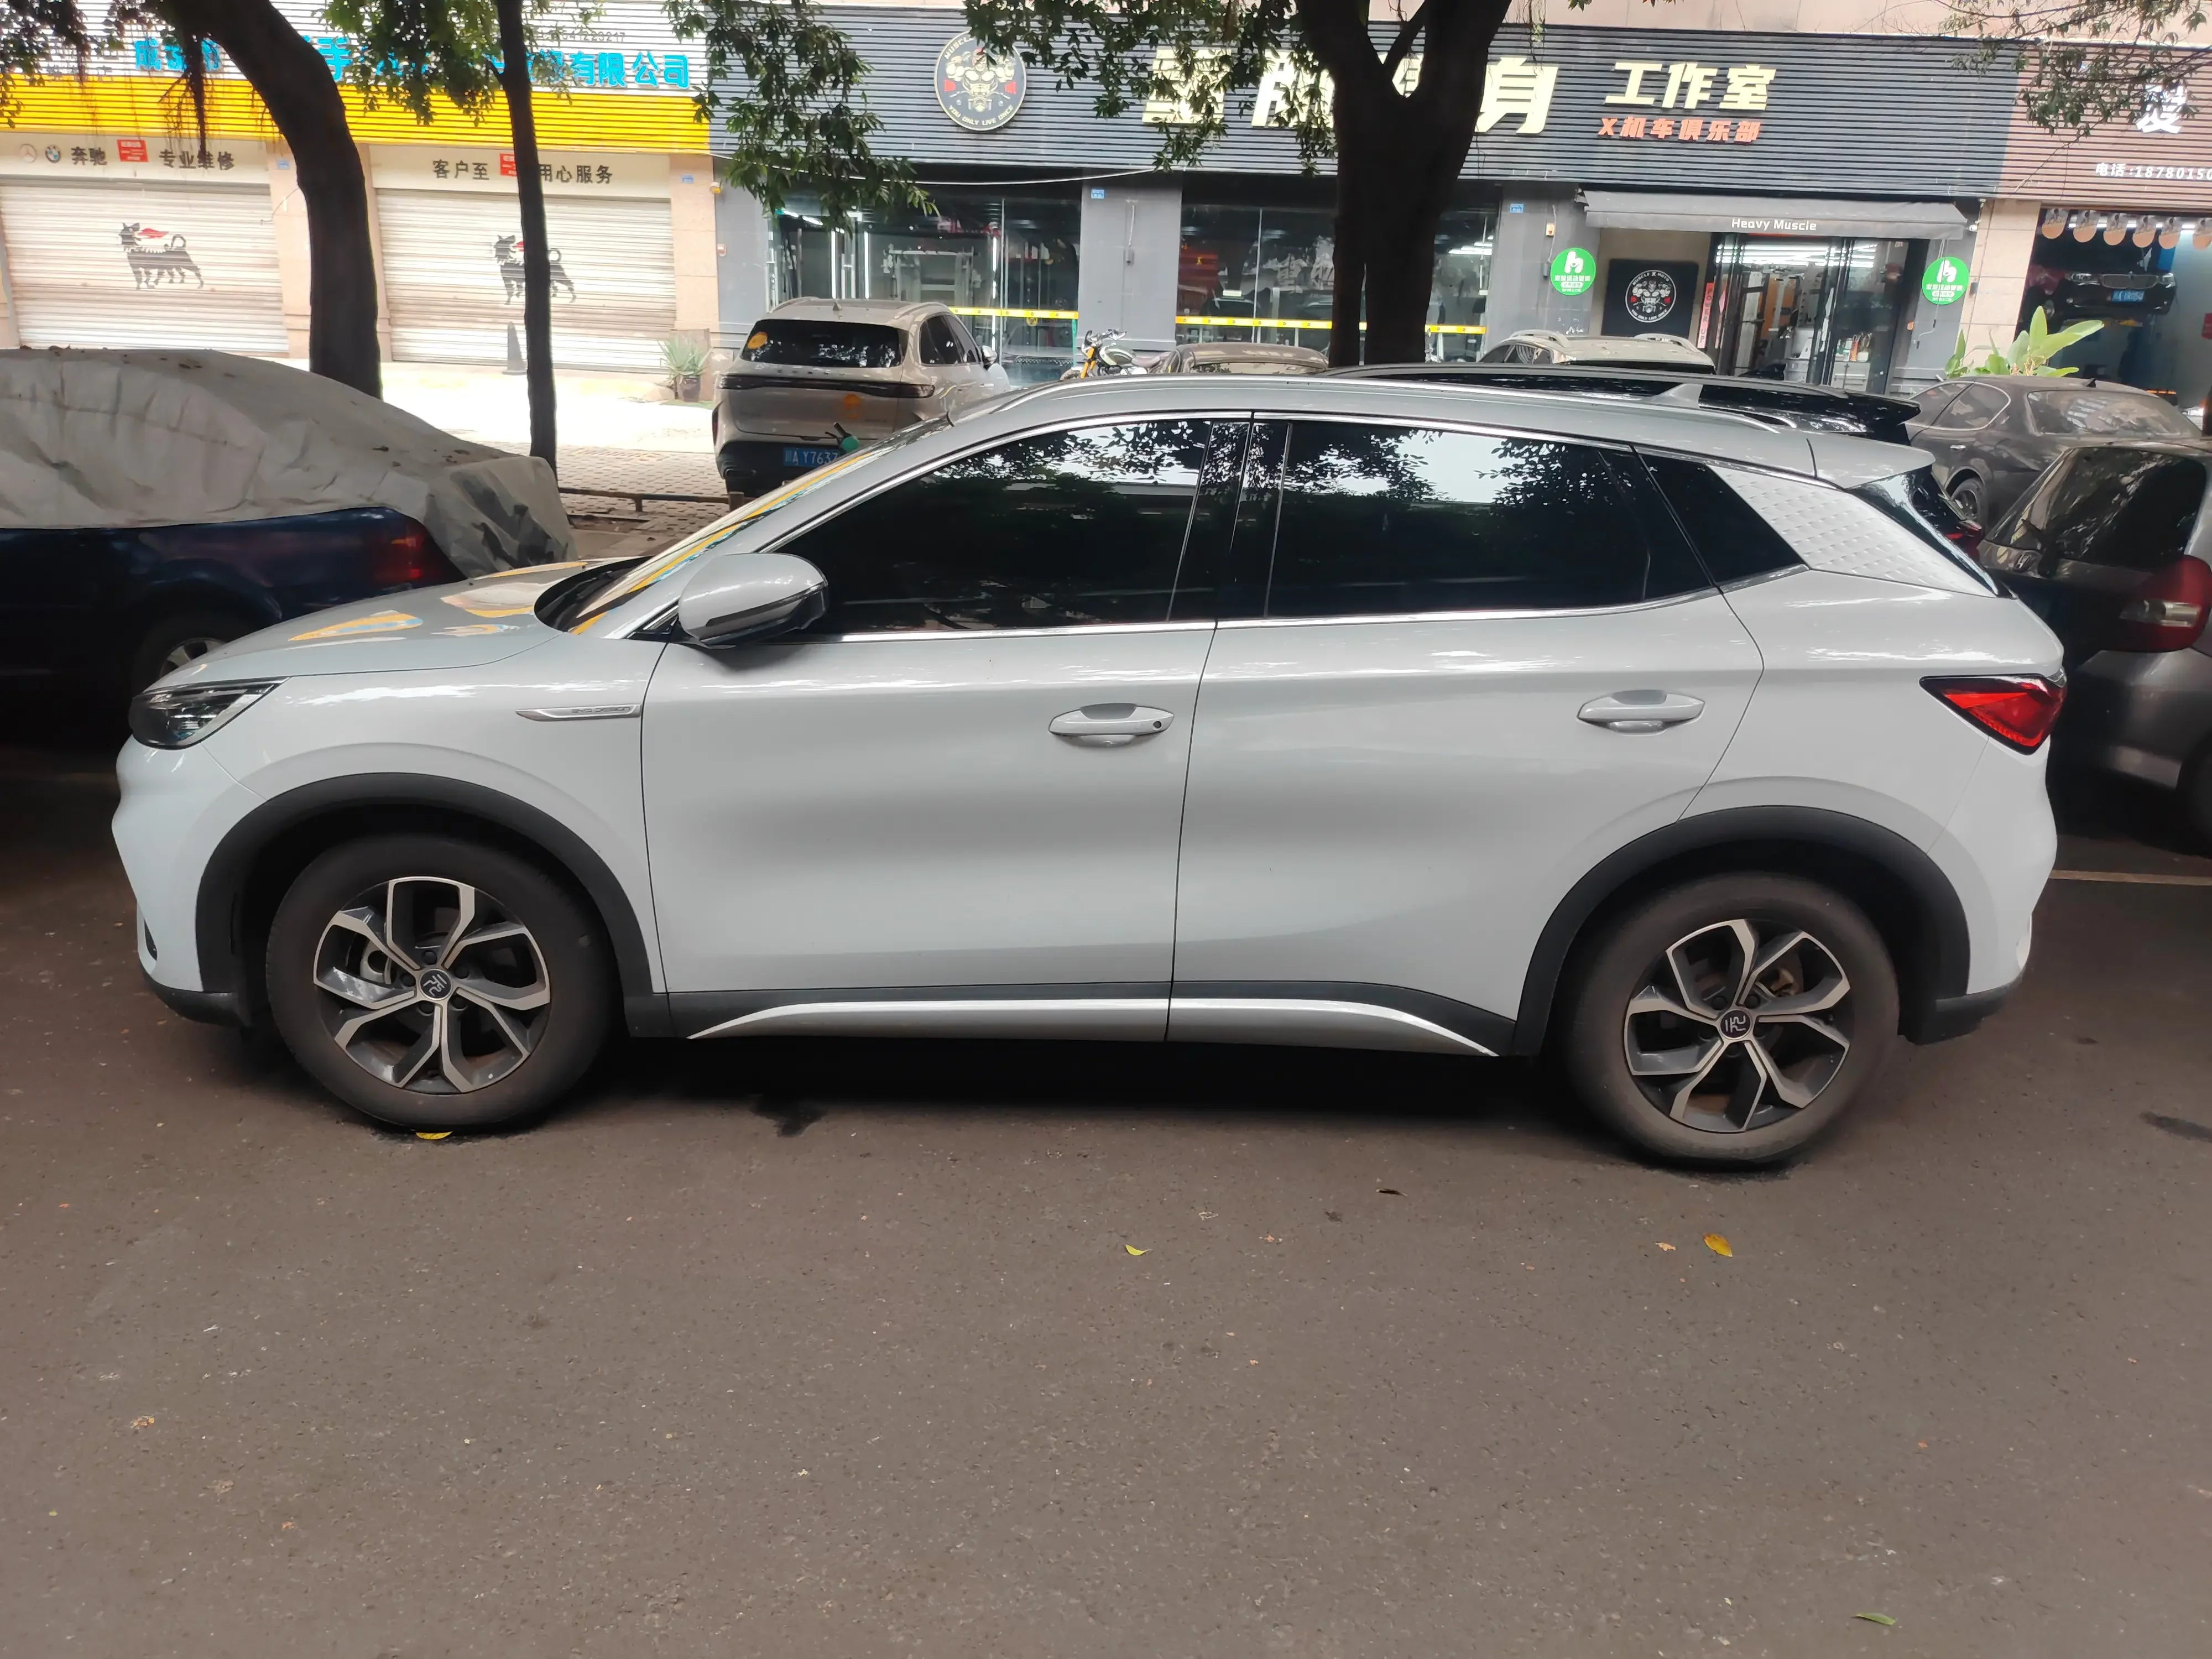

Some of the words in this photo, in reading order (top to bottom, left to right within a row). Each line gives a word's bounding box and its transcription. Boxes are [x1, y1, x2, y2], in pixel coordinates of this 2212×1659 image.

[943, 36, 974, 60] MUSCL
[1605, 61, 1777, 111] 工作室
[948, 105, 962, 118] YOU
[962, 115, 979, 126] ONLY
[998, 105, 1014, 120] ONCE
[71, 147, 108, 166] 奔驰
[1731, 218, 1770, 231] Heavy
[1773, 219, 1817, 231] Muscle
